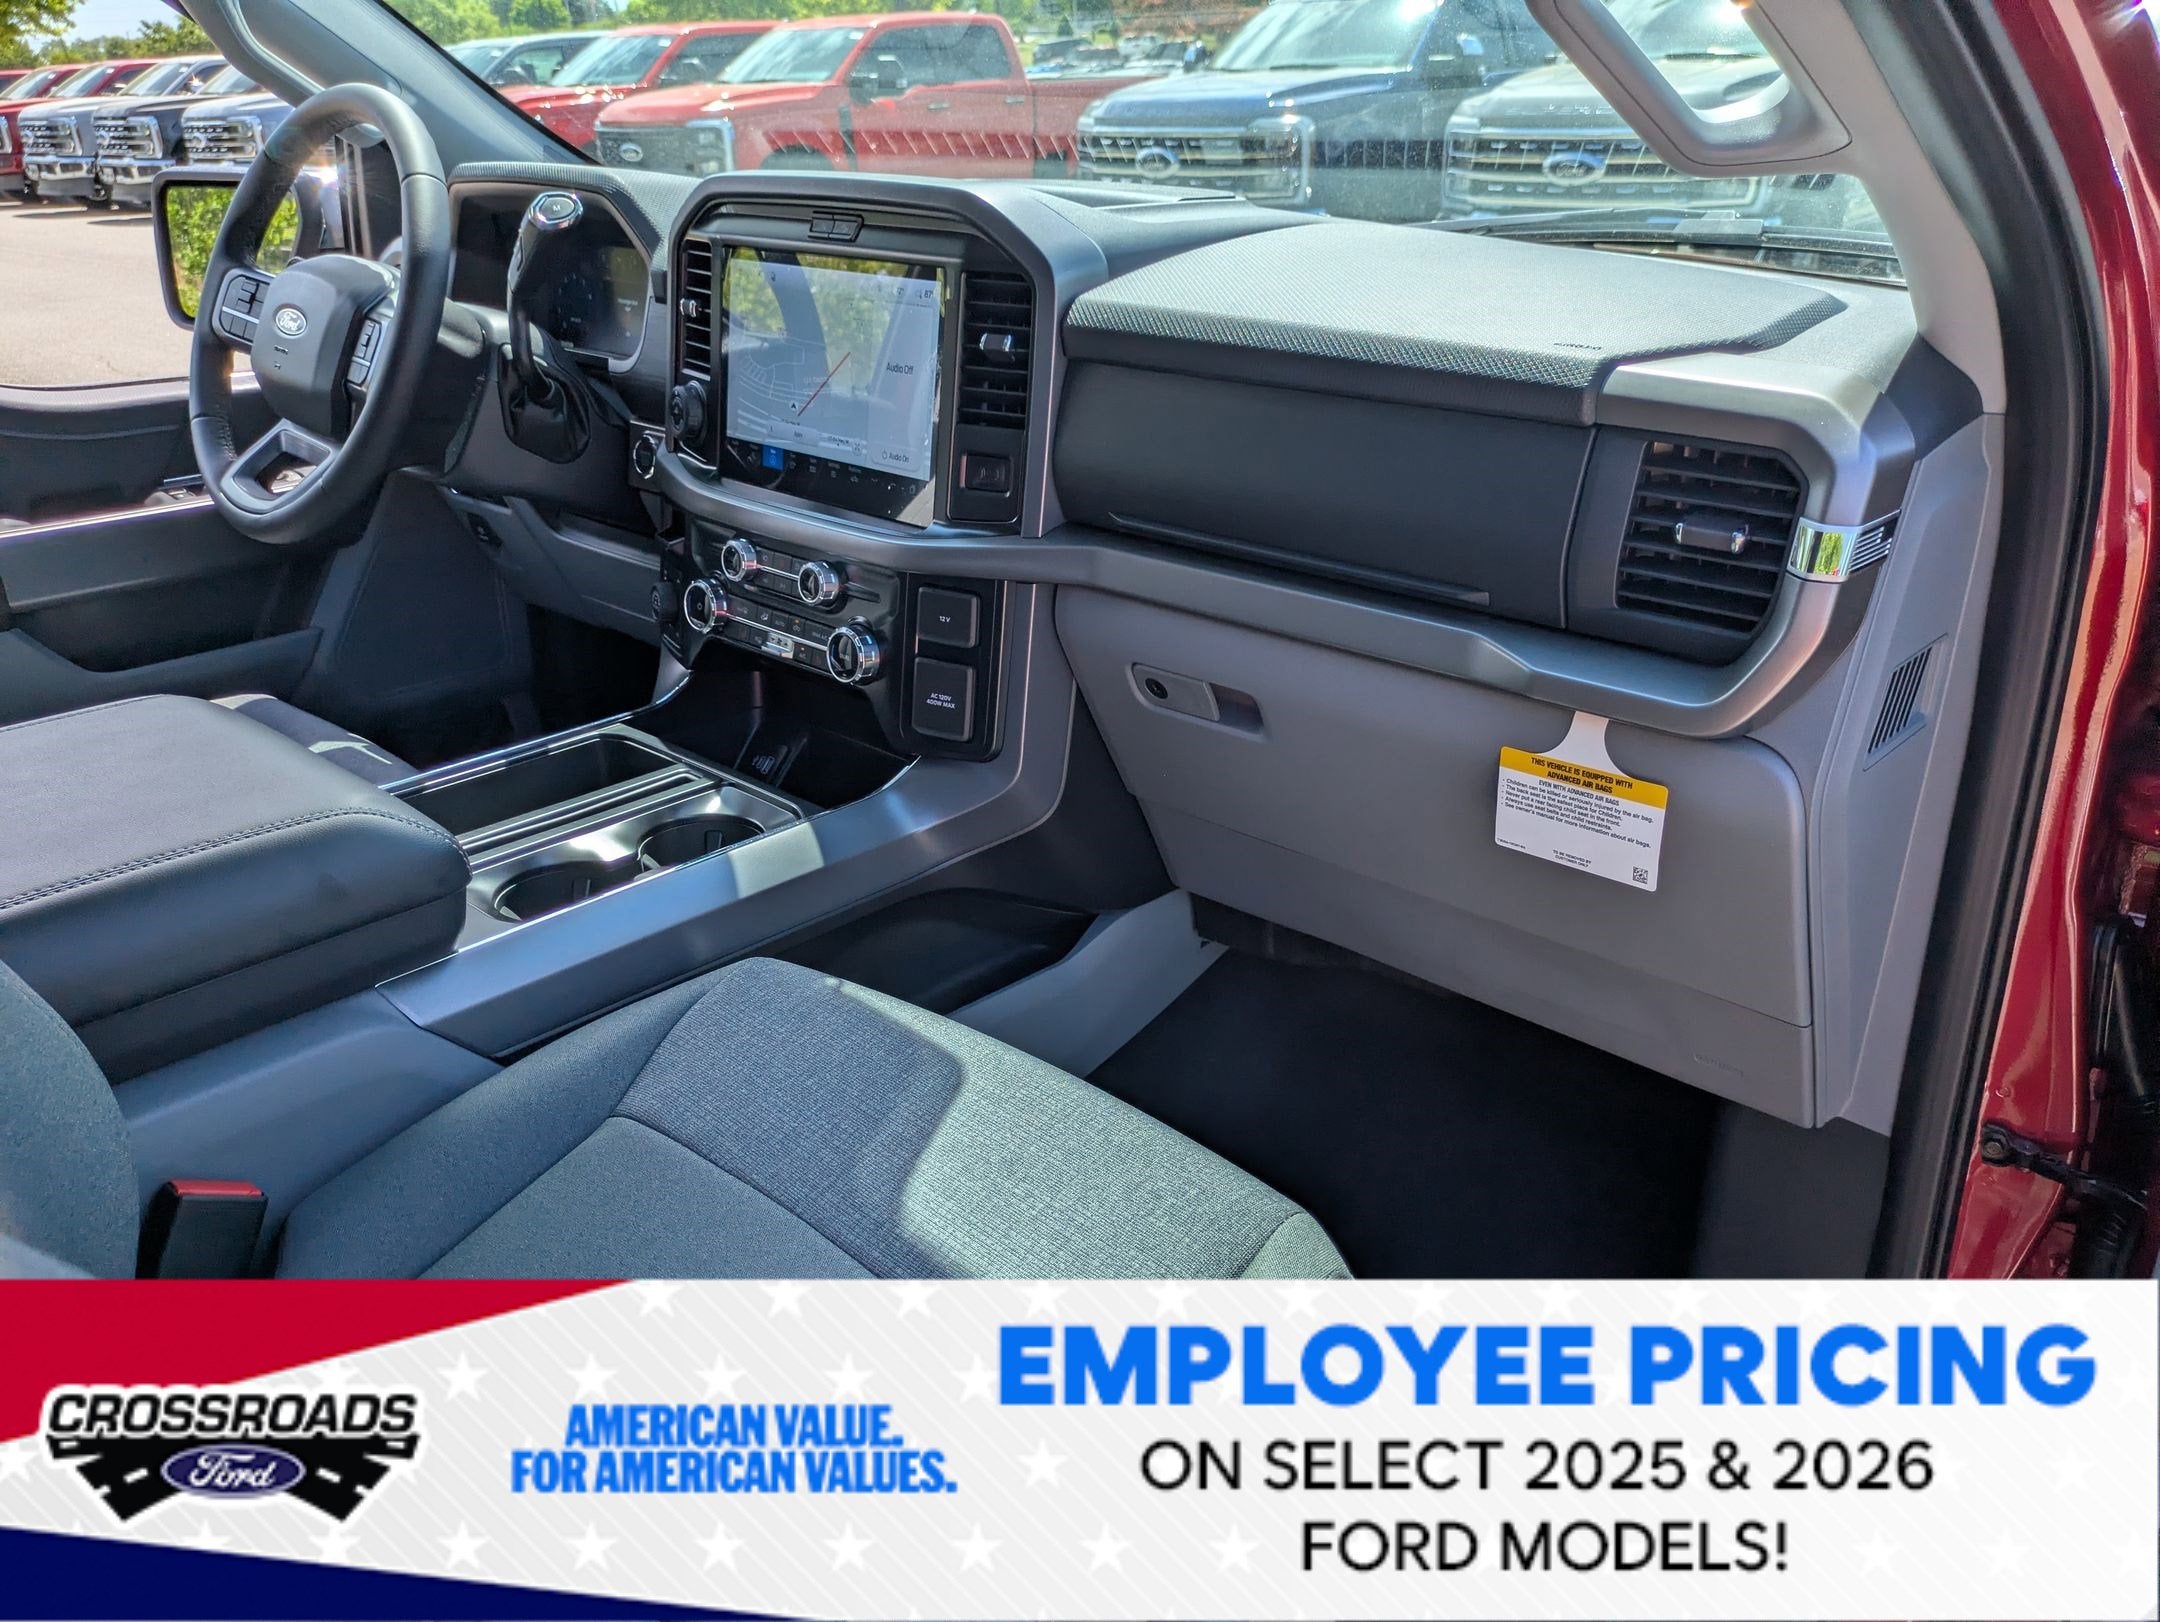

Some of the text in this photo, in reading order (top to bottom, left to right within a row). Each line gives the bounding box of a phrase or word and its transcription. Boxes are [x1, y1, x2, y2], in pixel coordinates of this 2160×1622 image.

[280, 311, 303, 331] Ford
[886, 362, 903, 373] Audio
[943, 701, 956, 709] MAX
[1531, 758, 1546, 766] THIS
[1547, 761, 1572, 773] VEHICLE
[1582, 770, 1614, 784] EQUIPPED
[1615, 779, 1633, 789] WITH
[1547, 771, 1613, 794] ADVANCED AIR BAGS
[1506, 778, 1528, 788] Children
[1594, 801, 1613, 812] injured
[1516, 787, 1528, 795] back
[1539, 780, 1552, 788] EVEN
[1553, 783, 1566, 791] WITH
[1567, 788, 1594, 799] ADVANCED
[1610, 832, 1626, 840] about
